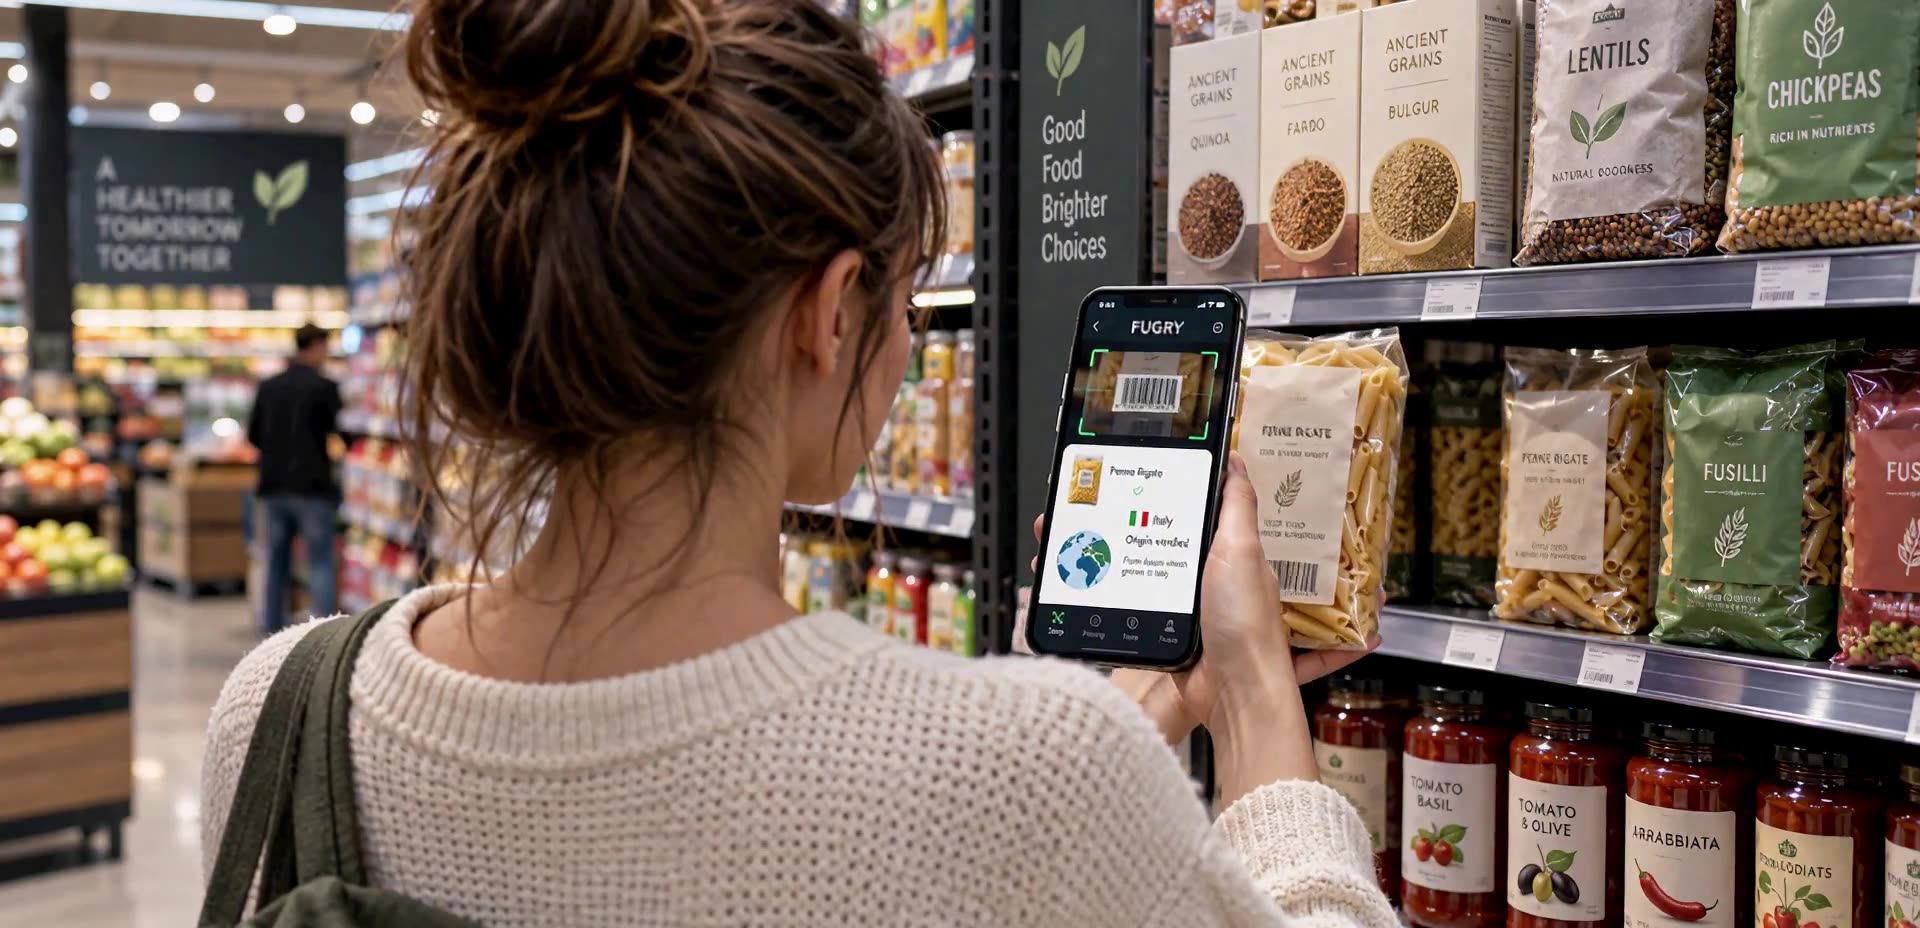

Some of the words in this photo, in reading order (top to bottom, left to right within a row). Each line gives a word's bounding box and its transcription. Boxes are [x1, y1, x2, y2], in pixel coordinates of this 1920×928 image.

[1385, 29, 1448, 54] ANCIENT
[1281, 49, 1336, 73] ANCIENT
[1389, 51, 1442, 74] GRAINS
[1567, 38, 1650, 74] LENTILS
[1187, 67, 1238, 89] ANCIENT
[1284, 70, 1331, 92] GRAINS
[1767, 69, 1882, 109] CHICKPEAS
[1190, 87, 1233, 107] GRAINS
[1388, 99, 1440, 120] BULGUR
[1042, 109, 1086, 145] Good
[1769, 131, 1794, 144] RICH
[1797, 129, 1808, 141] IN
[1190, 131, 1231, 152] QUINOA
[97, 156, 117, 181] A
[1042, 149, 1082, 183] Food
[97, 186, 235, 213] HEALTHIER
[1041, 190, 1108, 228] Brighter
[97, 216, 243, 242] TOMORROW
[97, 244, 232, 272] TOGETHER
[1041, 232, 1107, 263] Choices
[1131, 320, 1185, 335] FUGRY
[1703, 463, 1767, 483] FUSILLI
[1411, 775, 1463, 796] TOMATO
[1417, 794, 1453, 812] BASIL
[1519, 797, 1577, 819] TOMATO
[1521, 817, 1529, 830] &
[1531, 818, 1572, 838] OLIVE
[1632, 825, 1721, 851] ARRABBIATA
